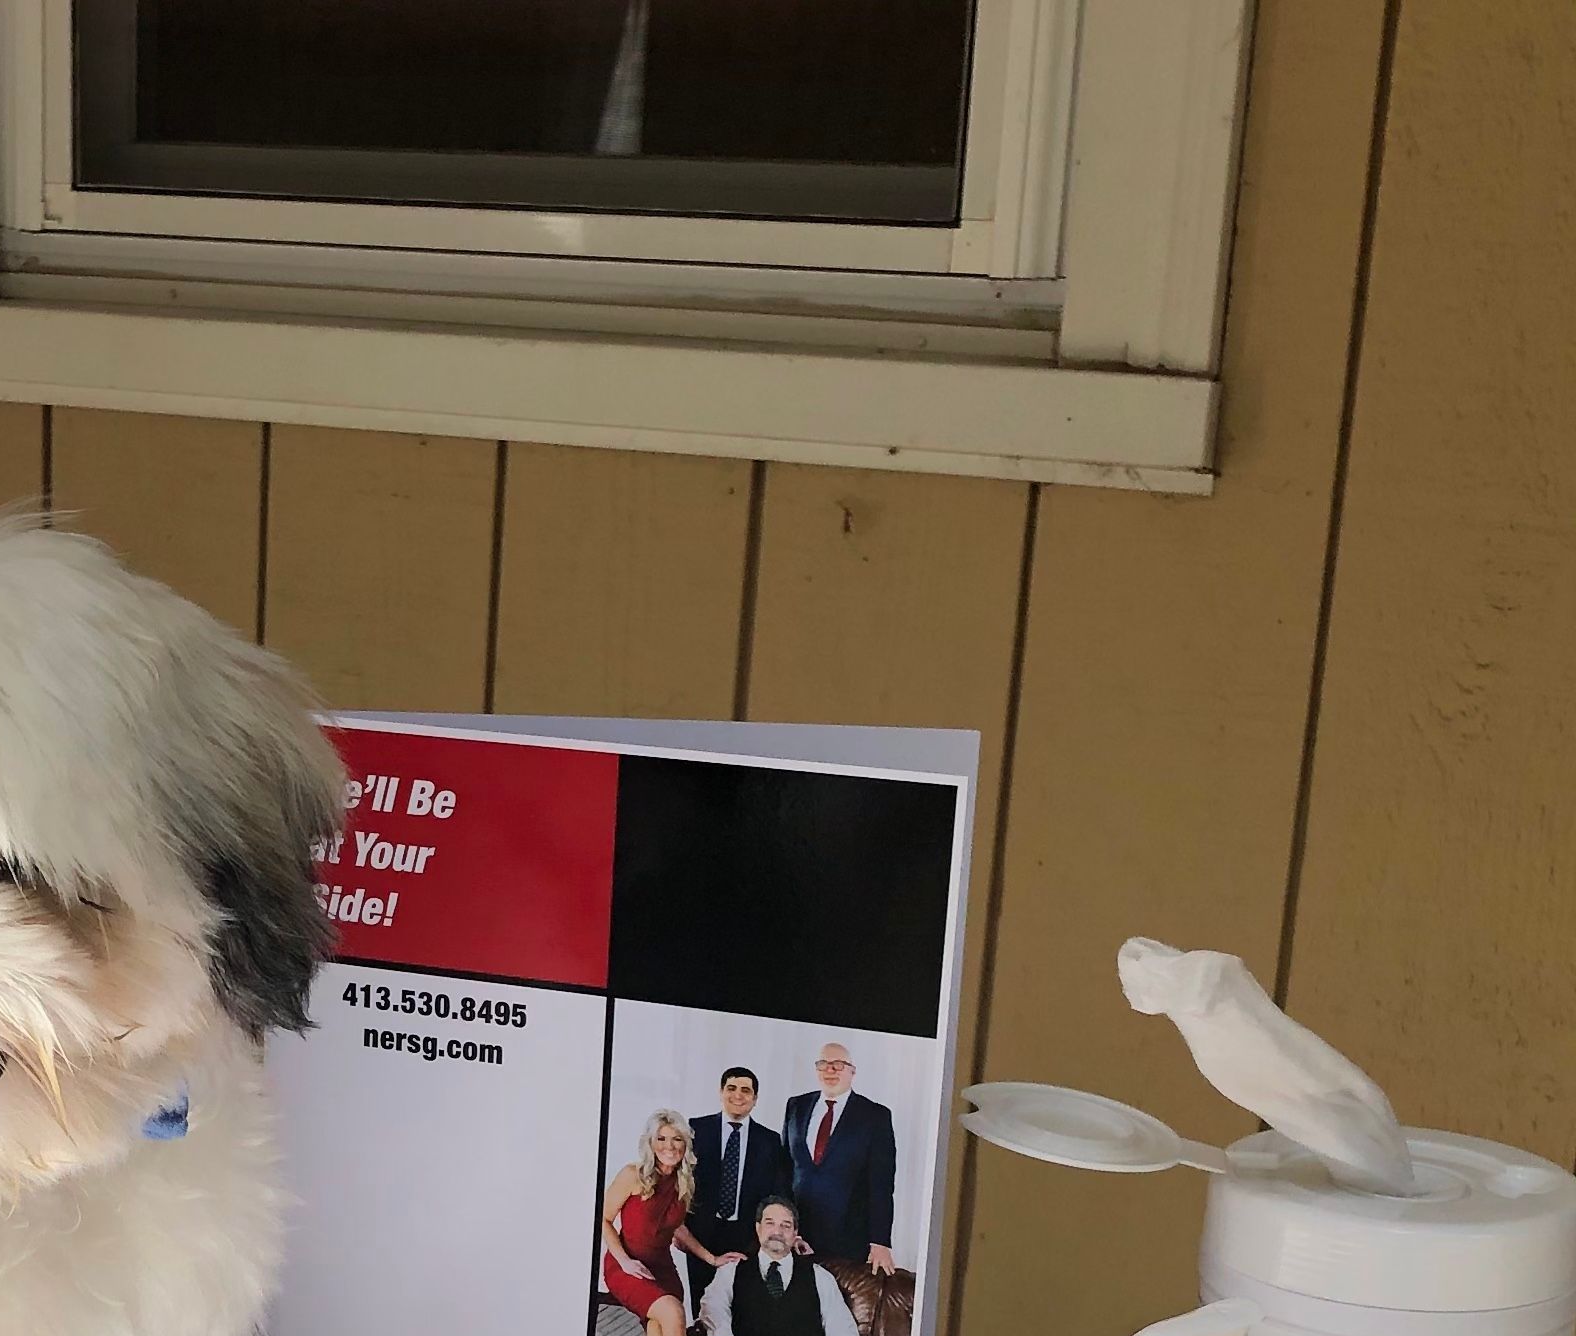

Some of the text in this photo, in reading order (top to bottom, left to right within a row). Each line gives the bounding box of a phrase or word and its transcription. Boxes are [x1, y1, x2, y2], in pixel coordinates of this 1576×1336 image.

[343, 774, 457, 819] e'll Be
[354, 830, 436, 874] Your
[313, 883, 400, 928] Side!
[341, 981, 528, 1029] 413.530.8495
[362, 1025, 504, 1065] nersg.com
